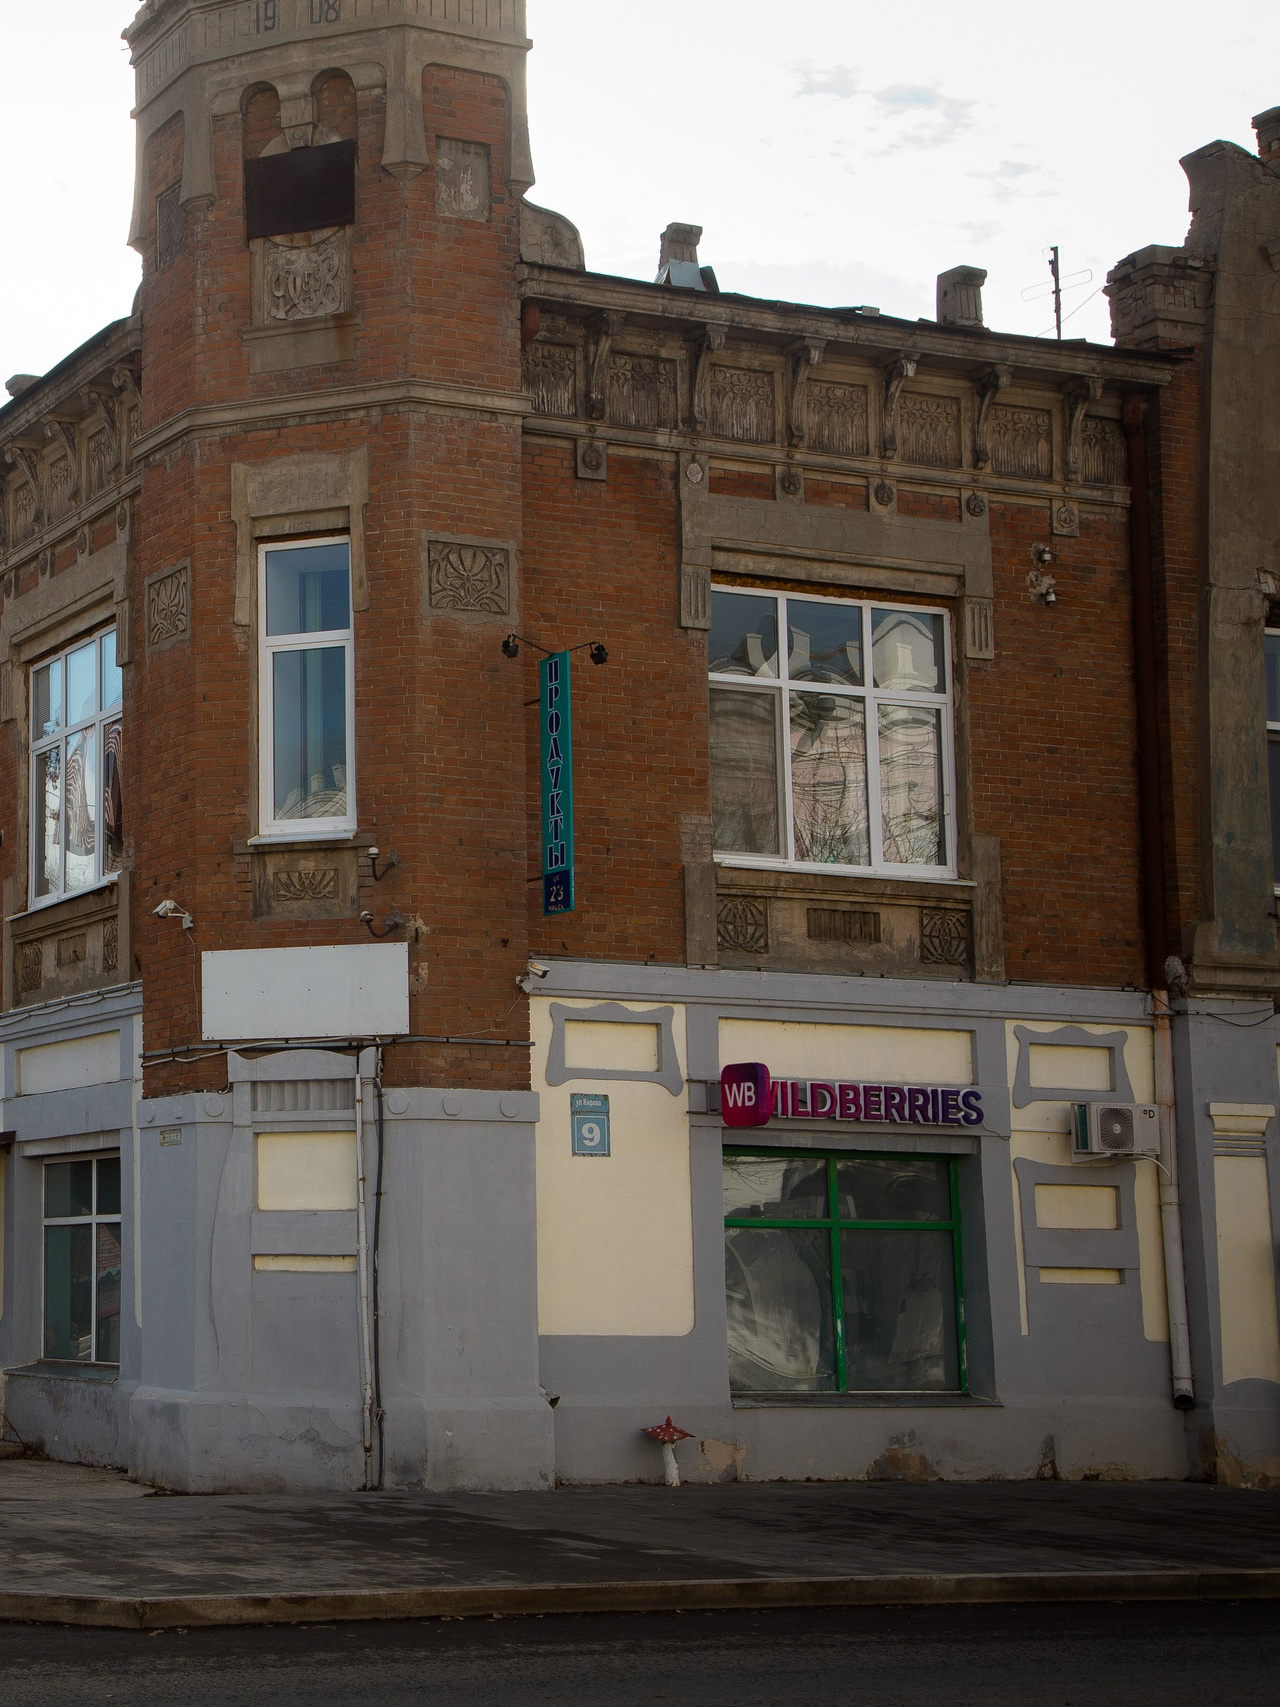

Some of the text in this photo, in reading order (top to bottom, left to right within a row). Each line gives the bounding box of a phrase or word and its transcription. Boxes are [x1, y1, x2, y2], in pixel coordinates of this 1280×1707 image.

[546, 658, 566, 870] ПРОДУКТЫ
[550, 885, 564, 902] 23
[583, 1098, 602, 1108] Кирова
[724, 1081, 756, 1108] WB
[581, 1122, 601, 1147] 9
